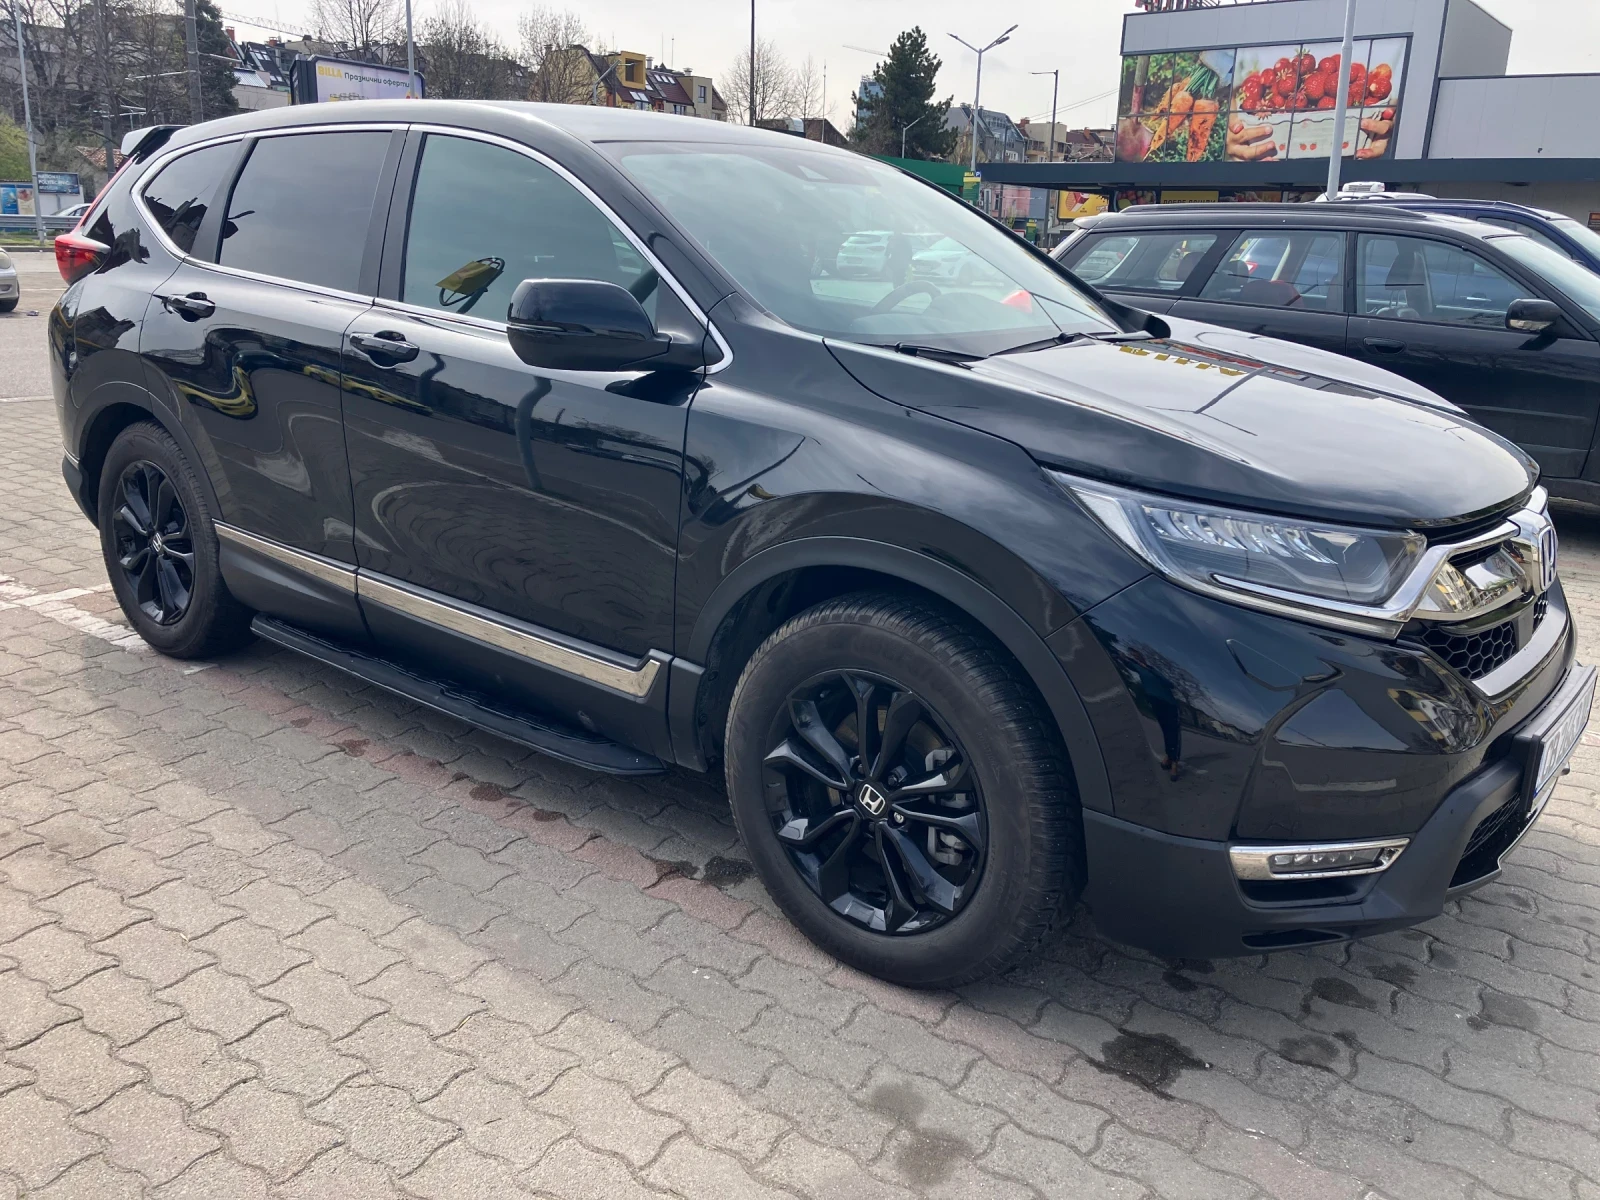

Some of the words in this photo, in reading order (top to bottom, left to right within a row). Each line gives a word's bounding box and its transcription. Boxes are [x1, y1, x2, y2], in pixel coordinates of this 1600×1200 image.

[317, 65, 343, 78] BILLA
[344, 72, 381, 84] Празнични
[382, 77, 410, 88] оферти
